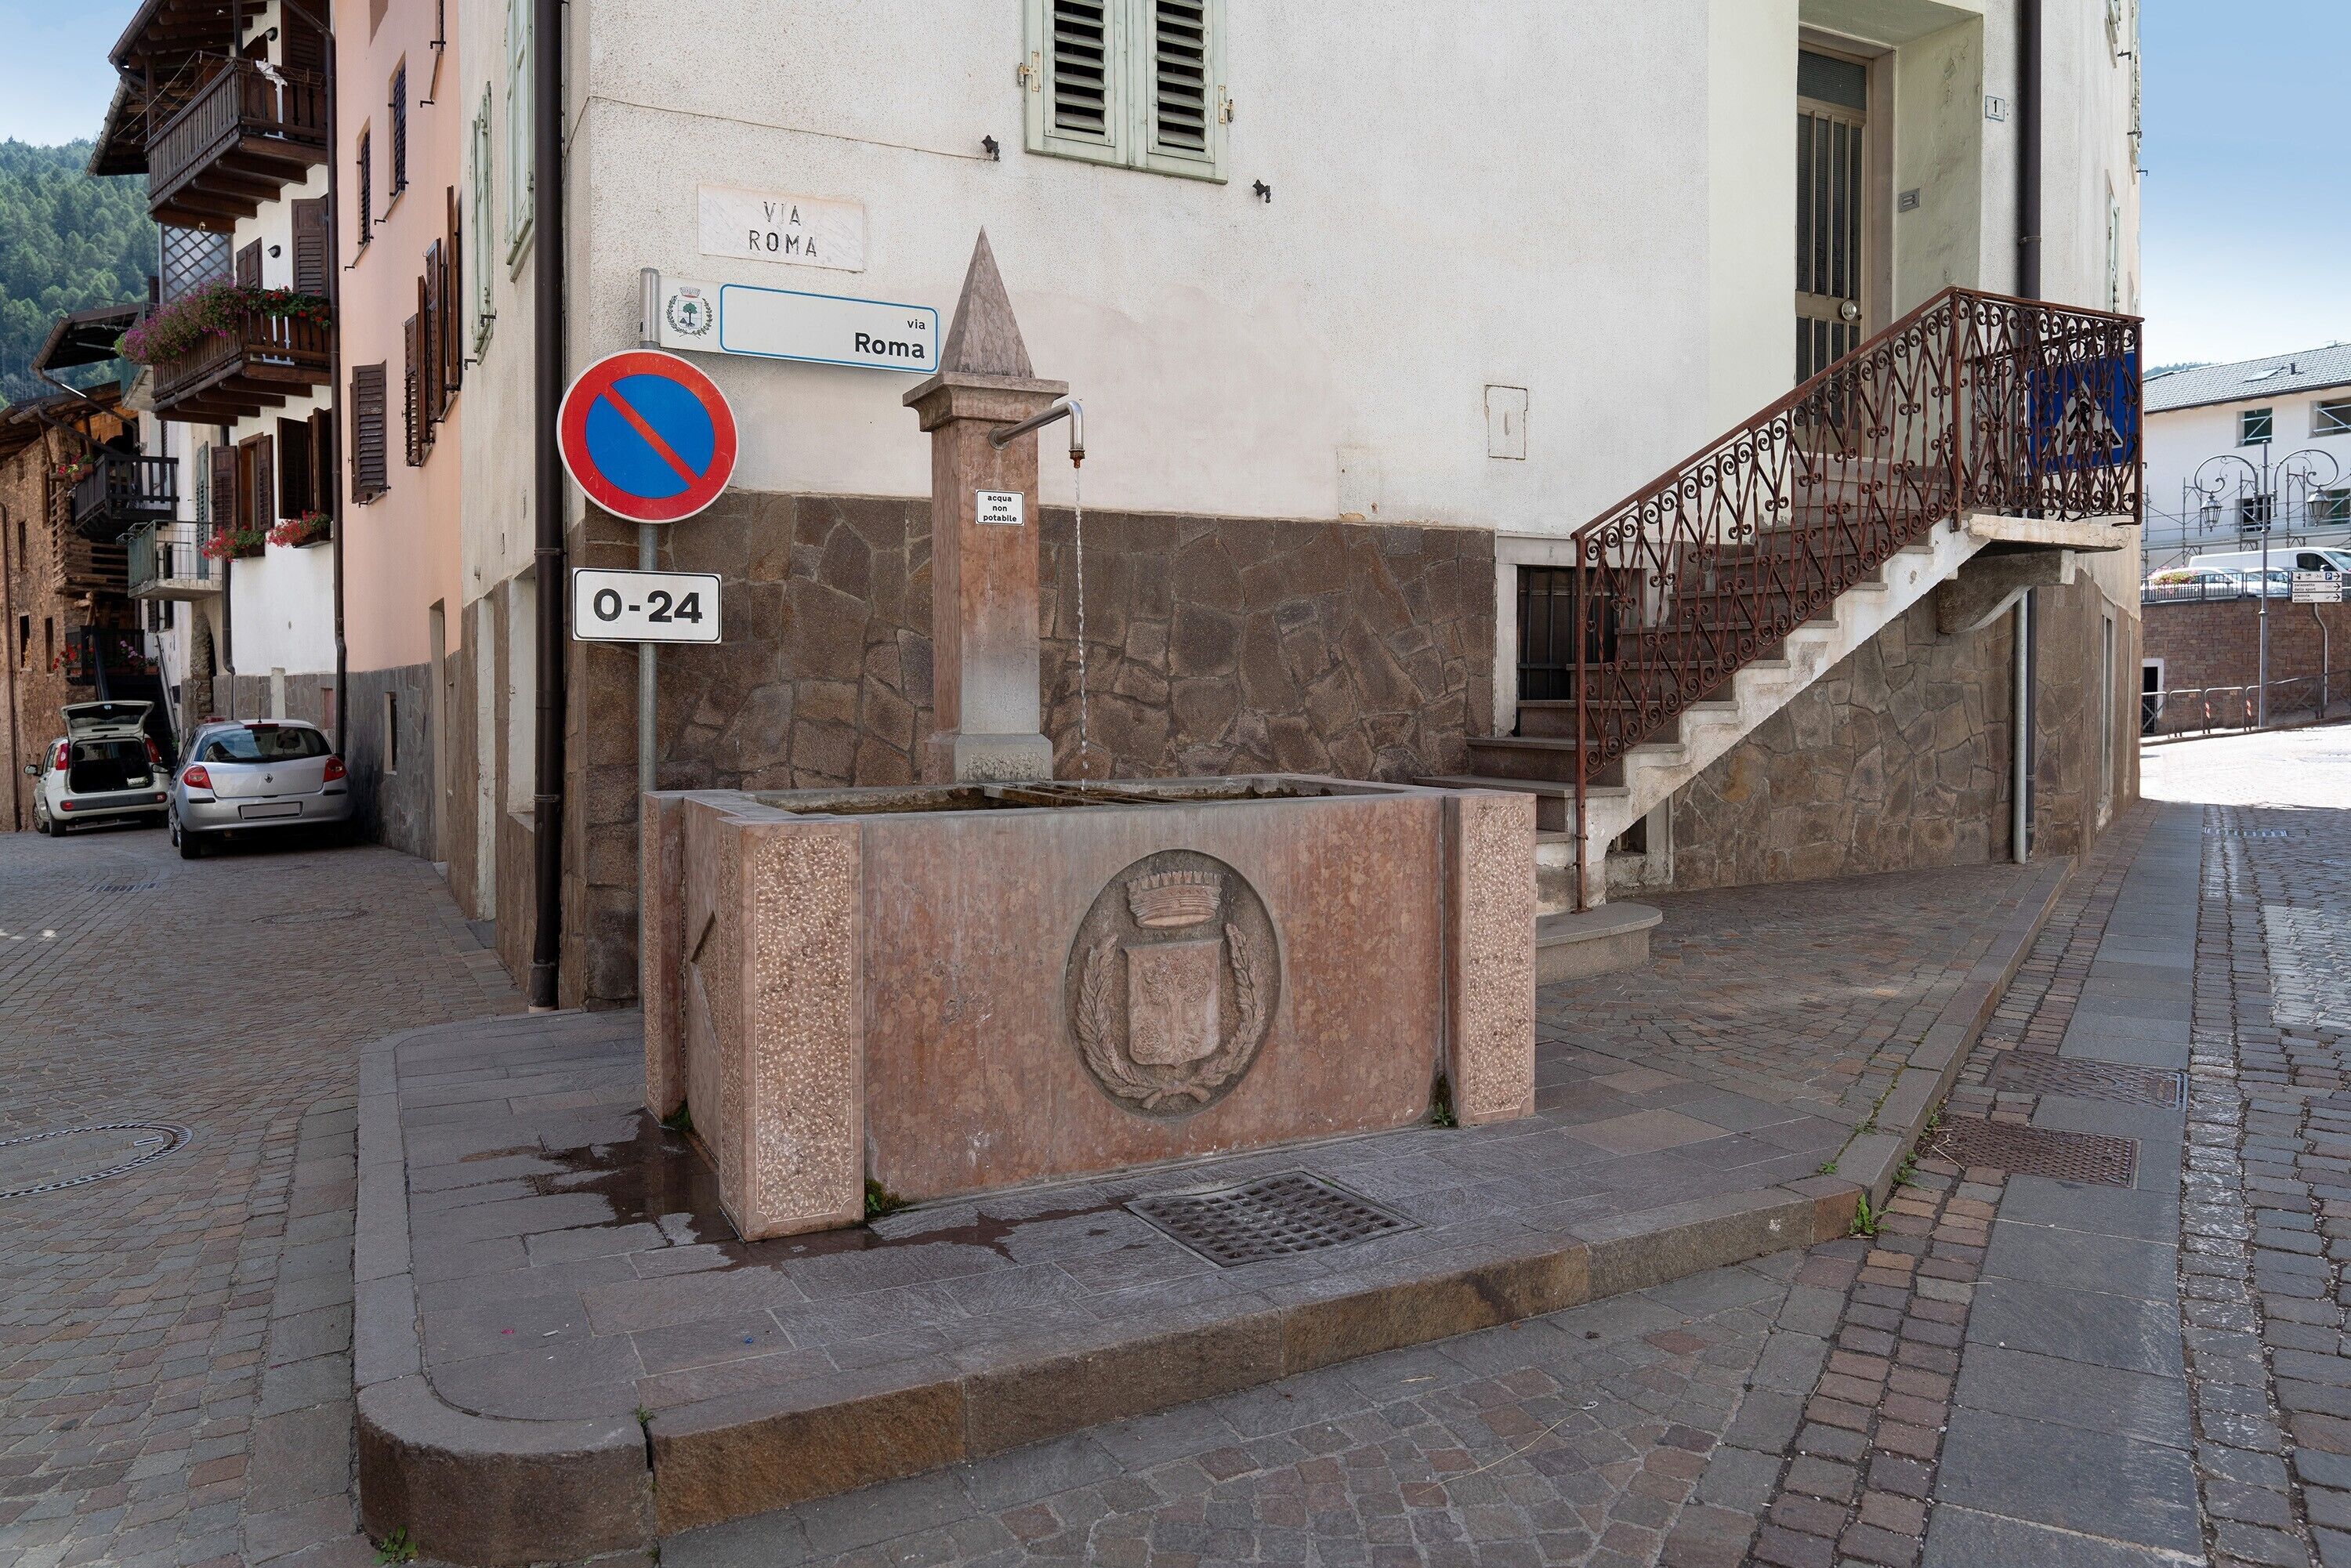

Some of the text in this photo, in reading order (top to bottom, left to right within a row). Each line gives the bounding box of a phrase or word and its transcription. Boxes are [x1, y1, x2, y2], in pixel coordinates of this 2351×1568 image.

[1994, 99, 1998, 113] 1
[763, 201, 802, 226] VIA
[748, 230, 817, 257] ROMA
[907, 318, 926, 330] via
[855, 332, 926, 358] Roma
[593, 588, 703, 624] 0-24
